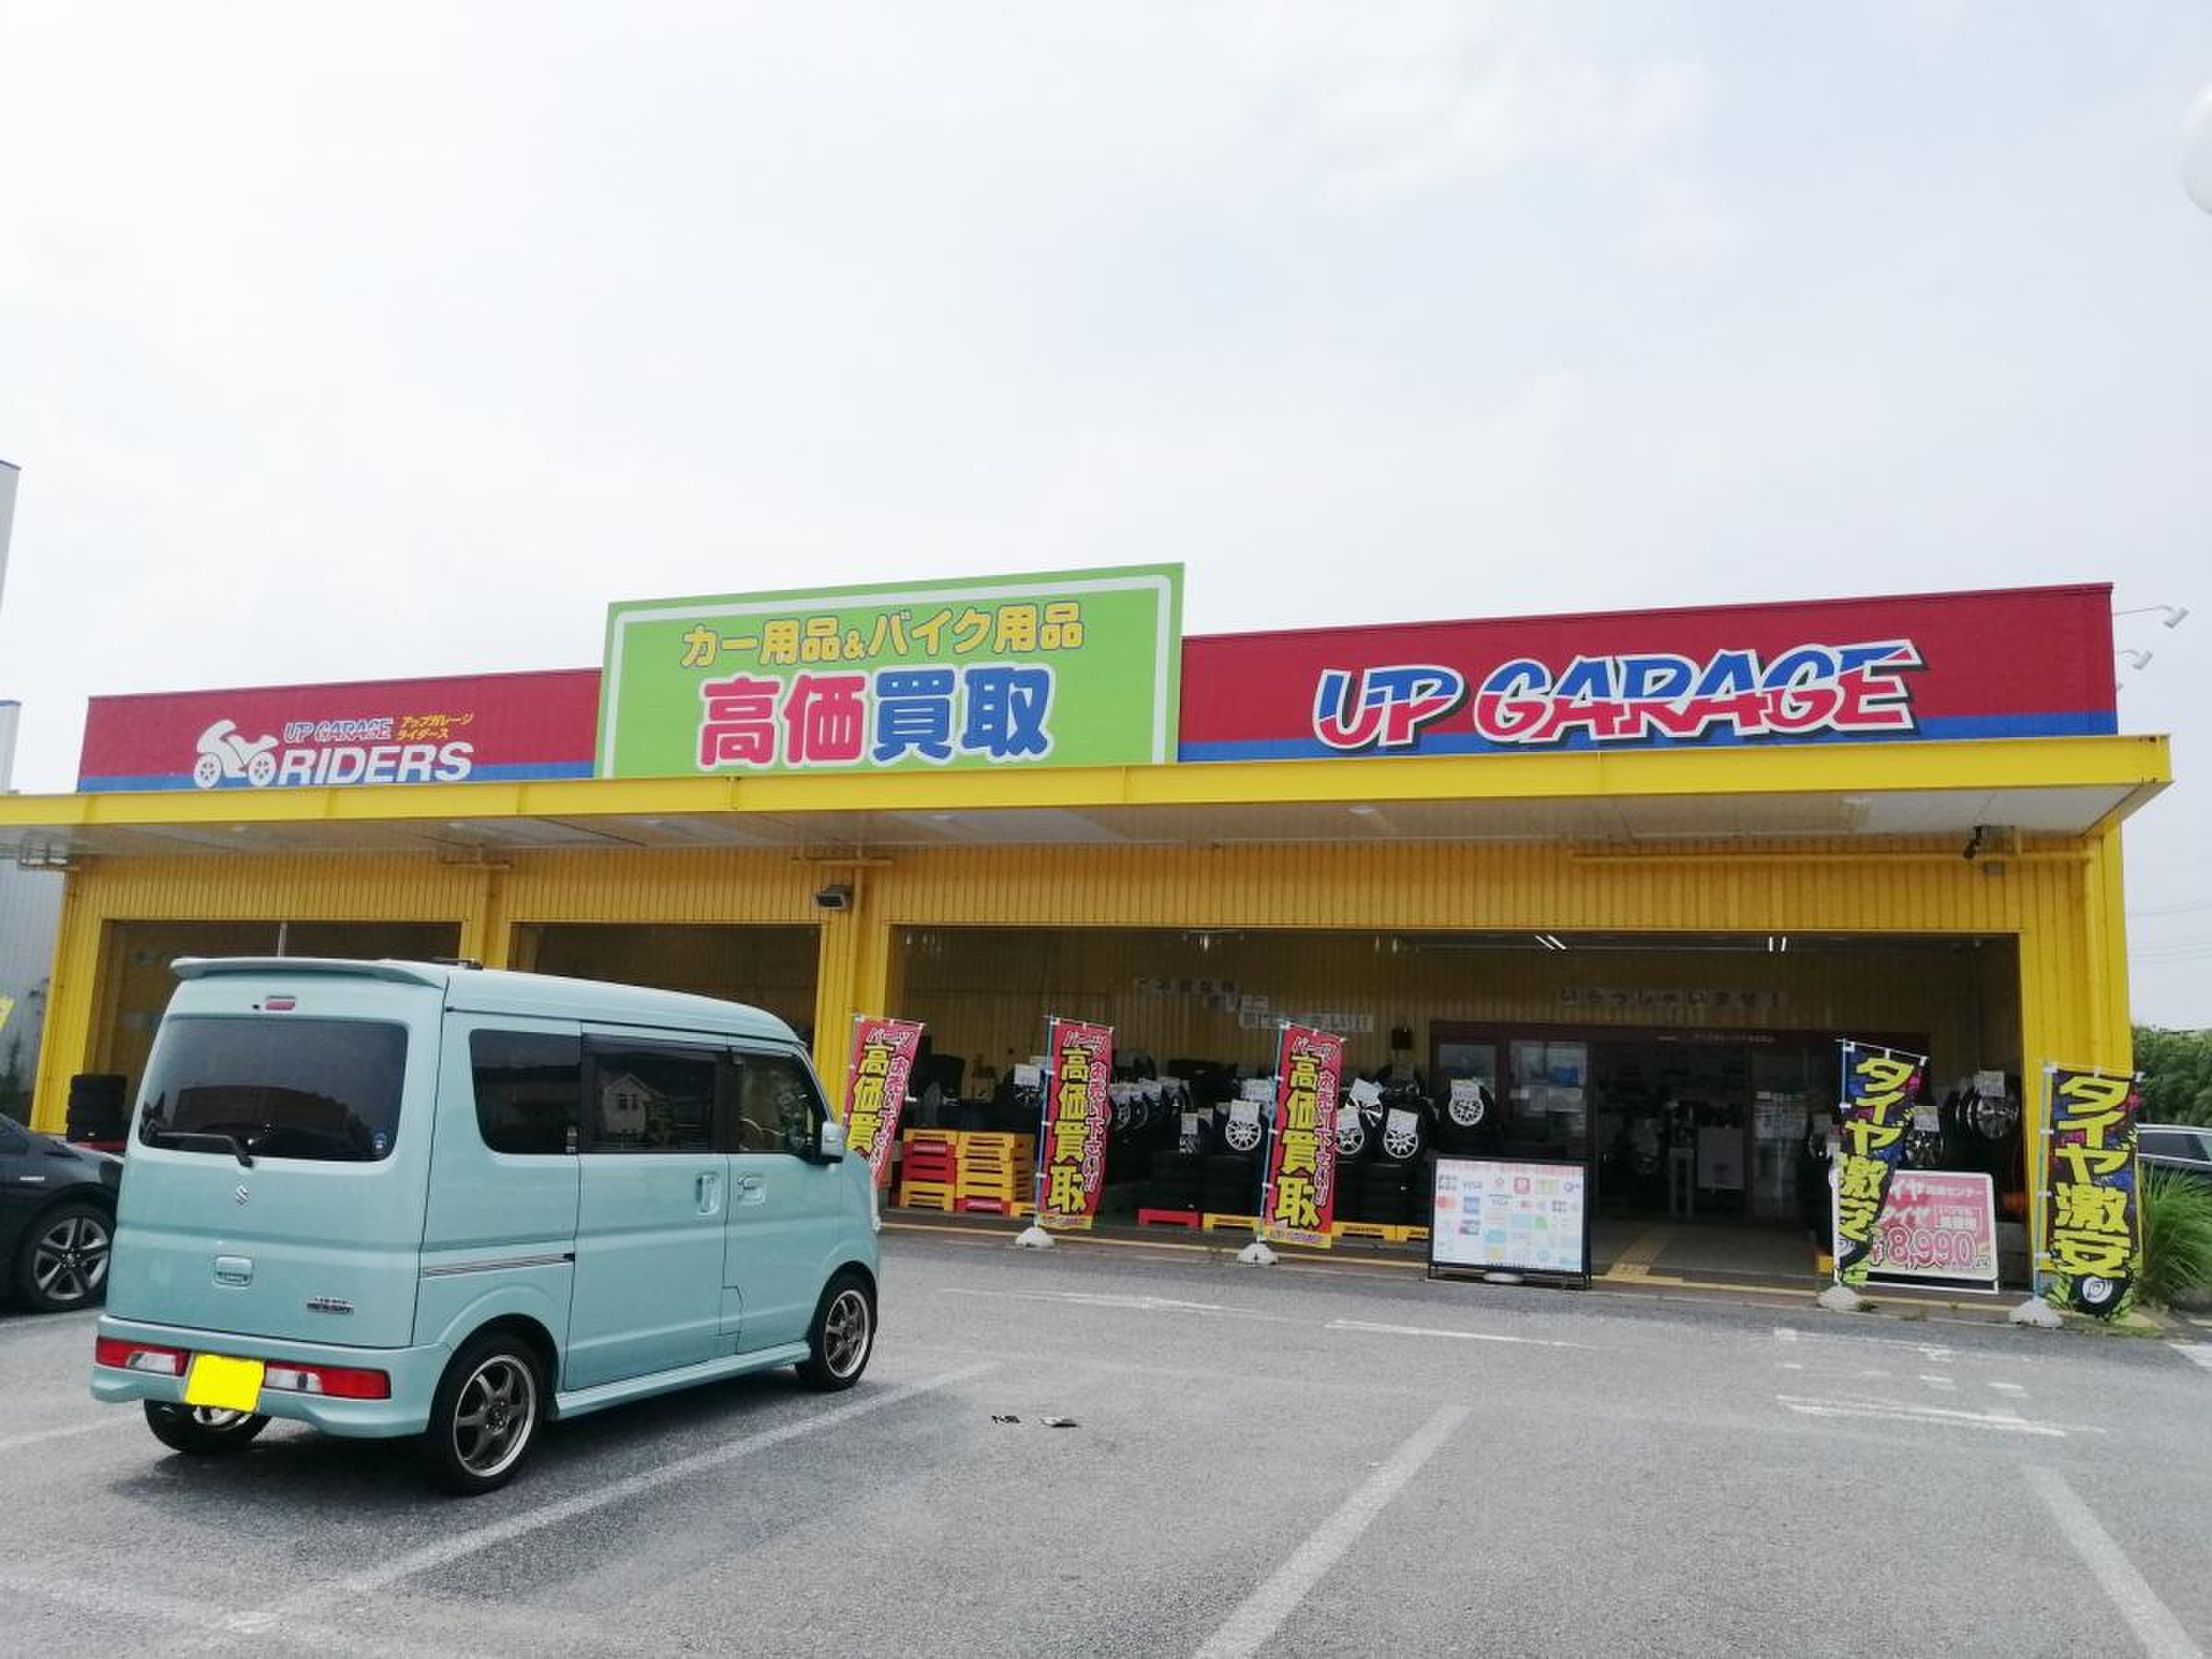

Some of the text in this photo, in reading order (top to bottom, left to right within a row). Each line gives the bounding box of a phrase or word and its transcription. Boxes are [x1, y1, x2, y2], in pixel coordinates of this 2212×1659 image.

[680, 602, 1086, 667] カー用品&バイク用品
[284, 716, 394, 744] UP GARAGE
[699, 665, 1054, 769] 高価買取
[1312, 639, 1924, 751] UP GARAGE
[278, 741, 474, 784] RIDERS
[1047, 1047, 1092, 1215] 高価買取
[1275, 1053, 1320, 1228] 高価買取
[2054, 1079, 2132, 1279] タイヤ激安
